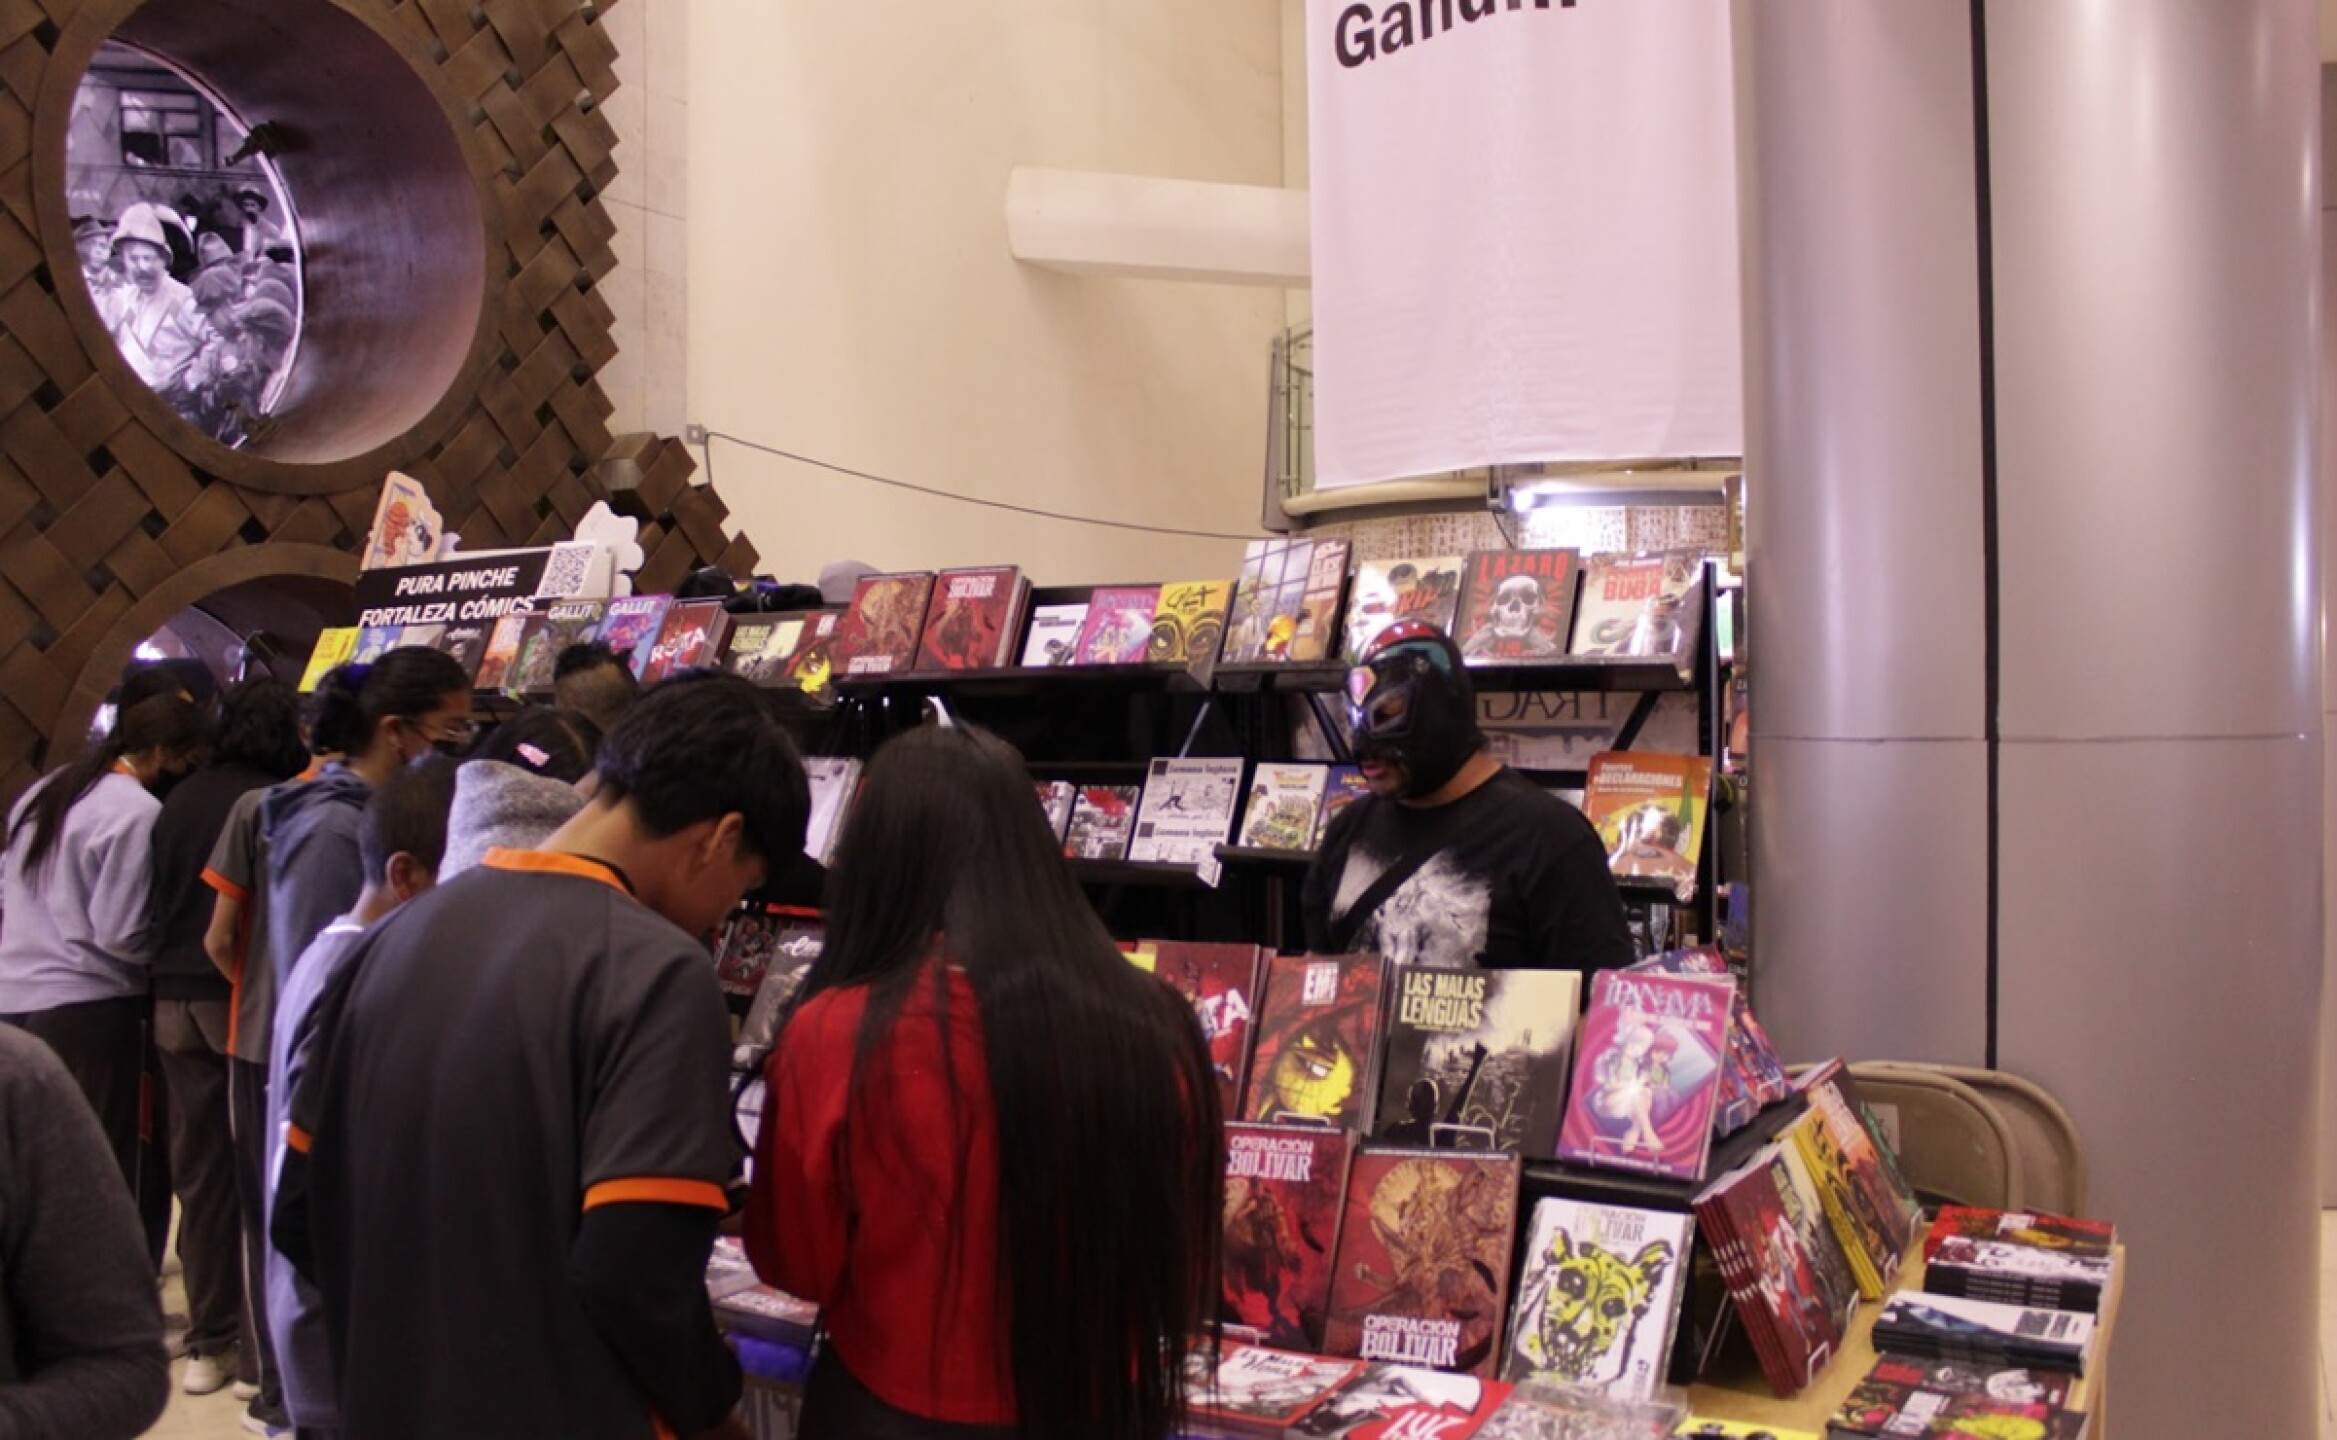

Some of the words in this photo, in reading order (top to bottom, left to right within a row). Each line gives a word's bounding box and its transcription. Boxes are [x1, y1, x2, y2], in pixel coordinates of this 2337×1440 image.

[1335, 0, 1577, 68] Gan
[395, 573, 445, 597] PURA
[447, 566, 519, 592] PINCHE
[358, 602, 456, 627] FORTALEZA
[460, 593, 536, 620] CÓMICS
[1404, 971, 1433, 996] LAS
[1435, 973, 1486, 1000] MALAS
[1401, 995, 1484, 1029] LENGUAS
